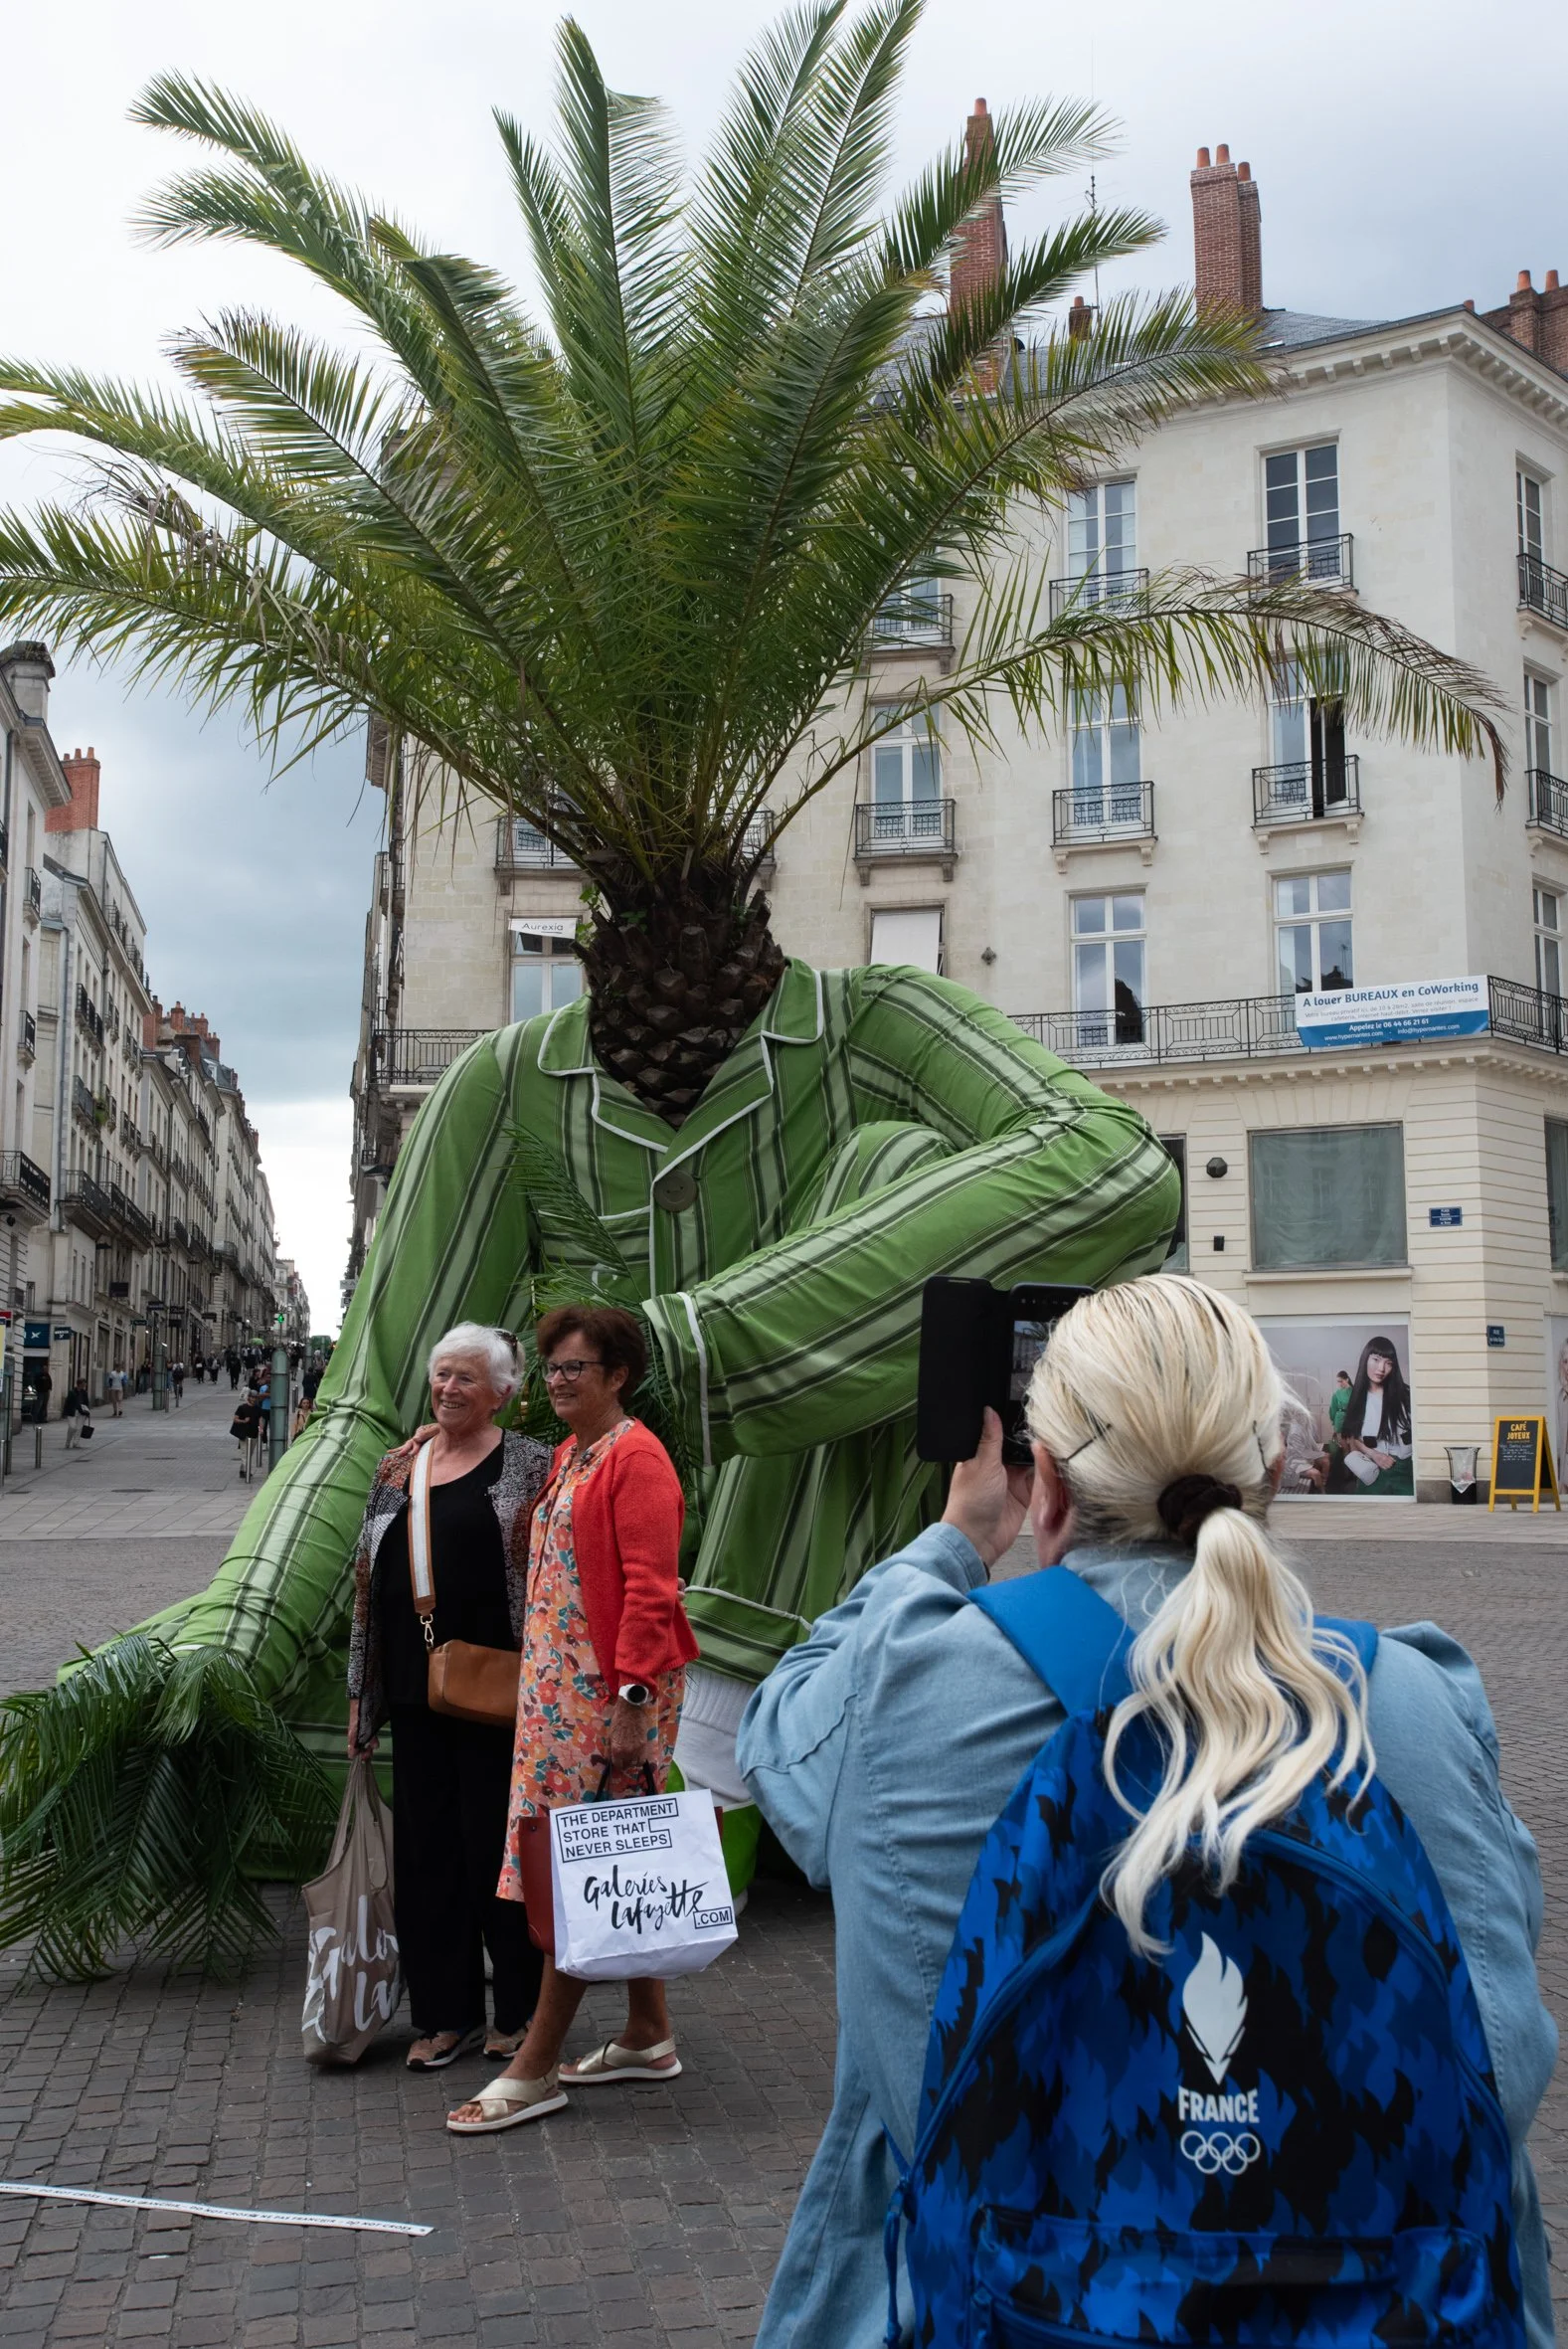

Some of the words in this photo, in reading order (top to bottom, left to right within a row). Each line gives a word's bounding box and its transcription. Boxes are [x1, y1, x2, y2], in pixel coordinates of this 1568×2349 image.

[522, 922, 563, 931] Aurexia
[1304, 997, 1310, 1006] A
[1314, 995, 1341, 1006] louer
[1345, 990, 1398, 1002] BUREAUX
[1418, 982, 1479, 995] CoWorking
[1349, 1023, 1374, 1032] Appelez
[1506, 1431, 1531, 1440] JOYEUX
[1510, 1421, 1527, 1431] CAFÉ
[561, 1813, 589, 1828] THE
[592, 1802, 674, 1823] DEPARTMENT
[563, 1826, 610, 1843] STORE
[613, 1821, 646, 1836] THAT
[566, 1841, 611, 1859] NEVER
[615, 1834, 668, 1851] SLEEPS
[584, 1865, 667, 1911] Galeries
[611, 1880, 710, 1934] Lafayette
[1178, 2084, 1260, 2123] FRANCE
